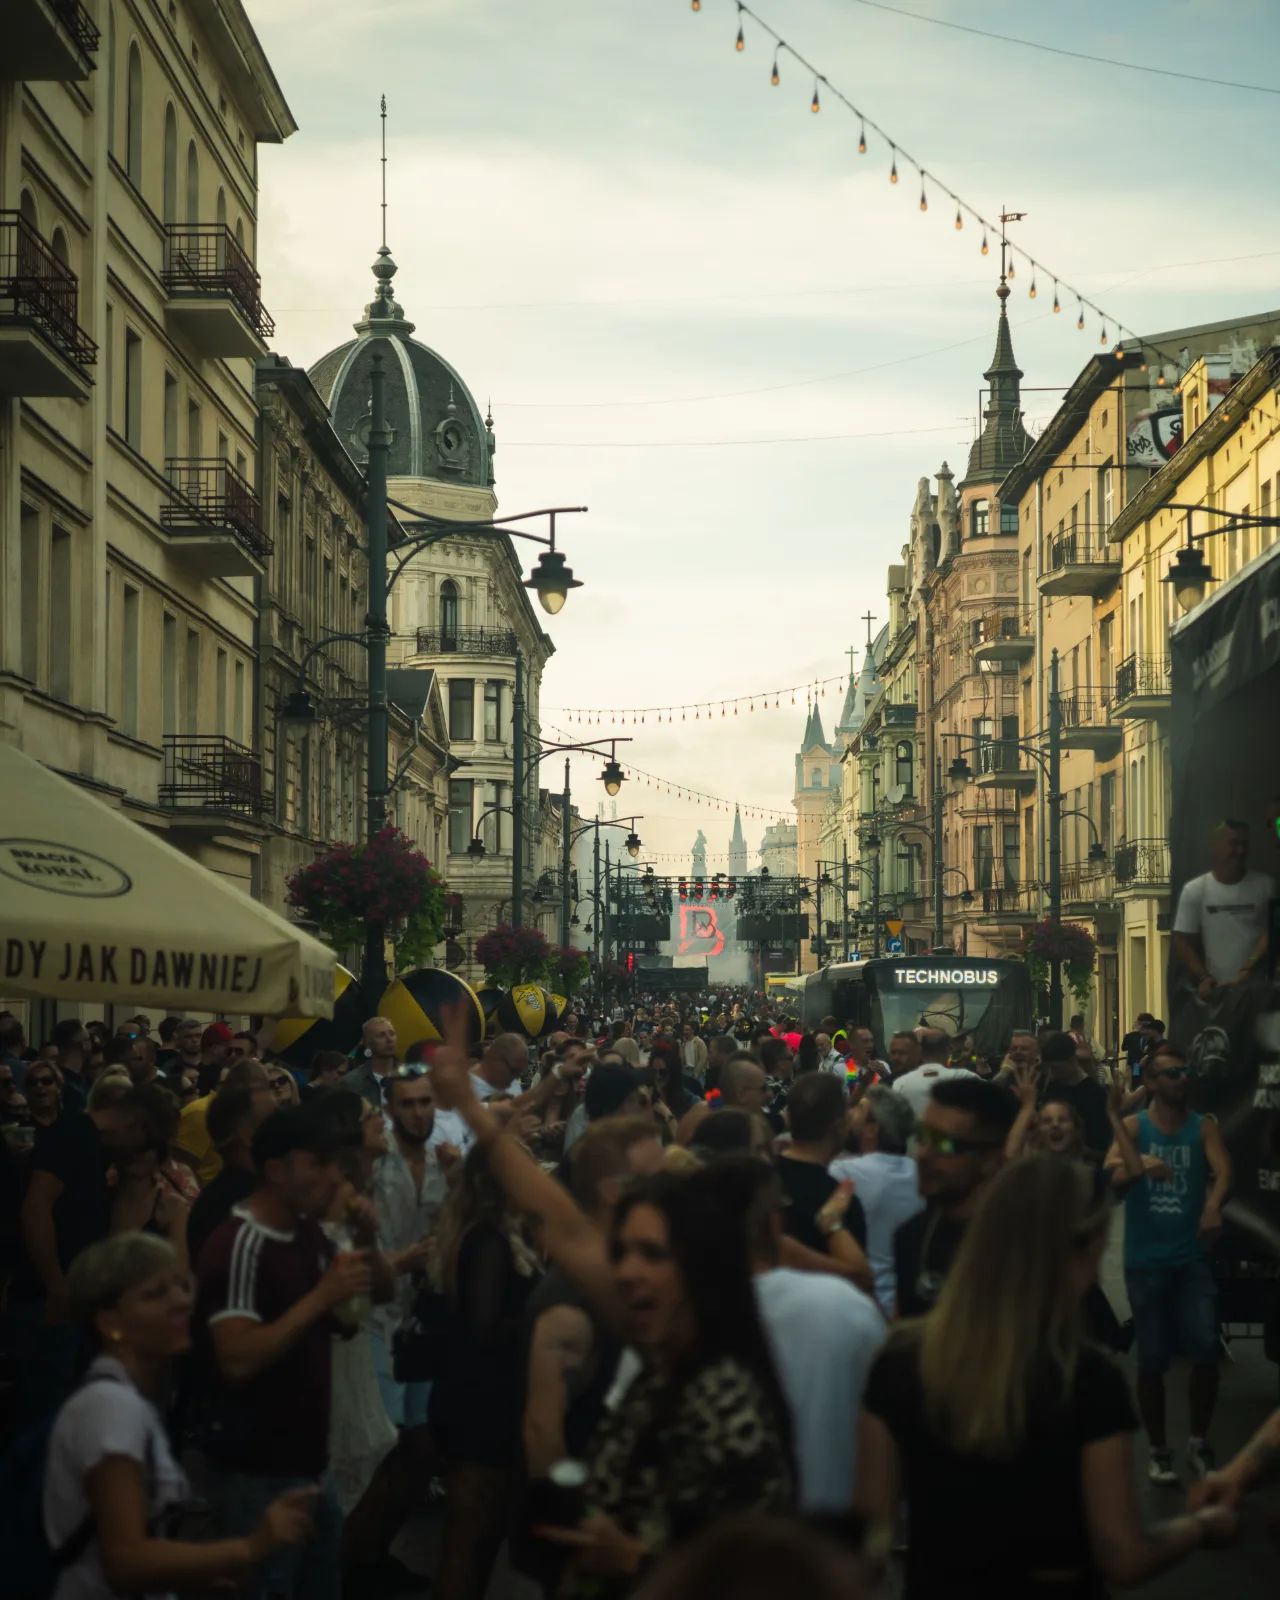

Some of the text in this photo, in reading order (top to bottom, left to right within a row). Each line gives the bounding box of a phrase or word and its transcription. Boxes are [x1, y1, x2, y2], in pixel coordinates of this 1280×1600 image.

[58, 942, 119, 985] JAK
[129, 947, 264, 993] DAWNIEJ
[895, 969, 998, 984] TECHNOBUS
